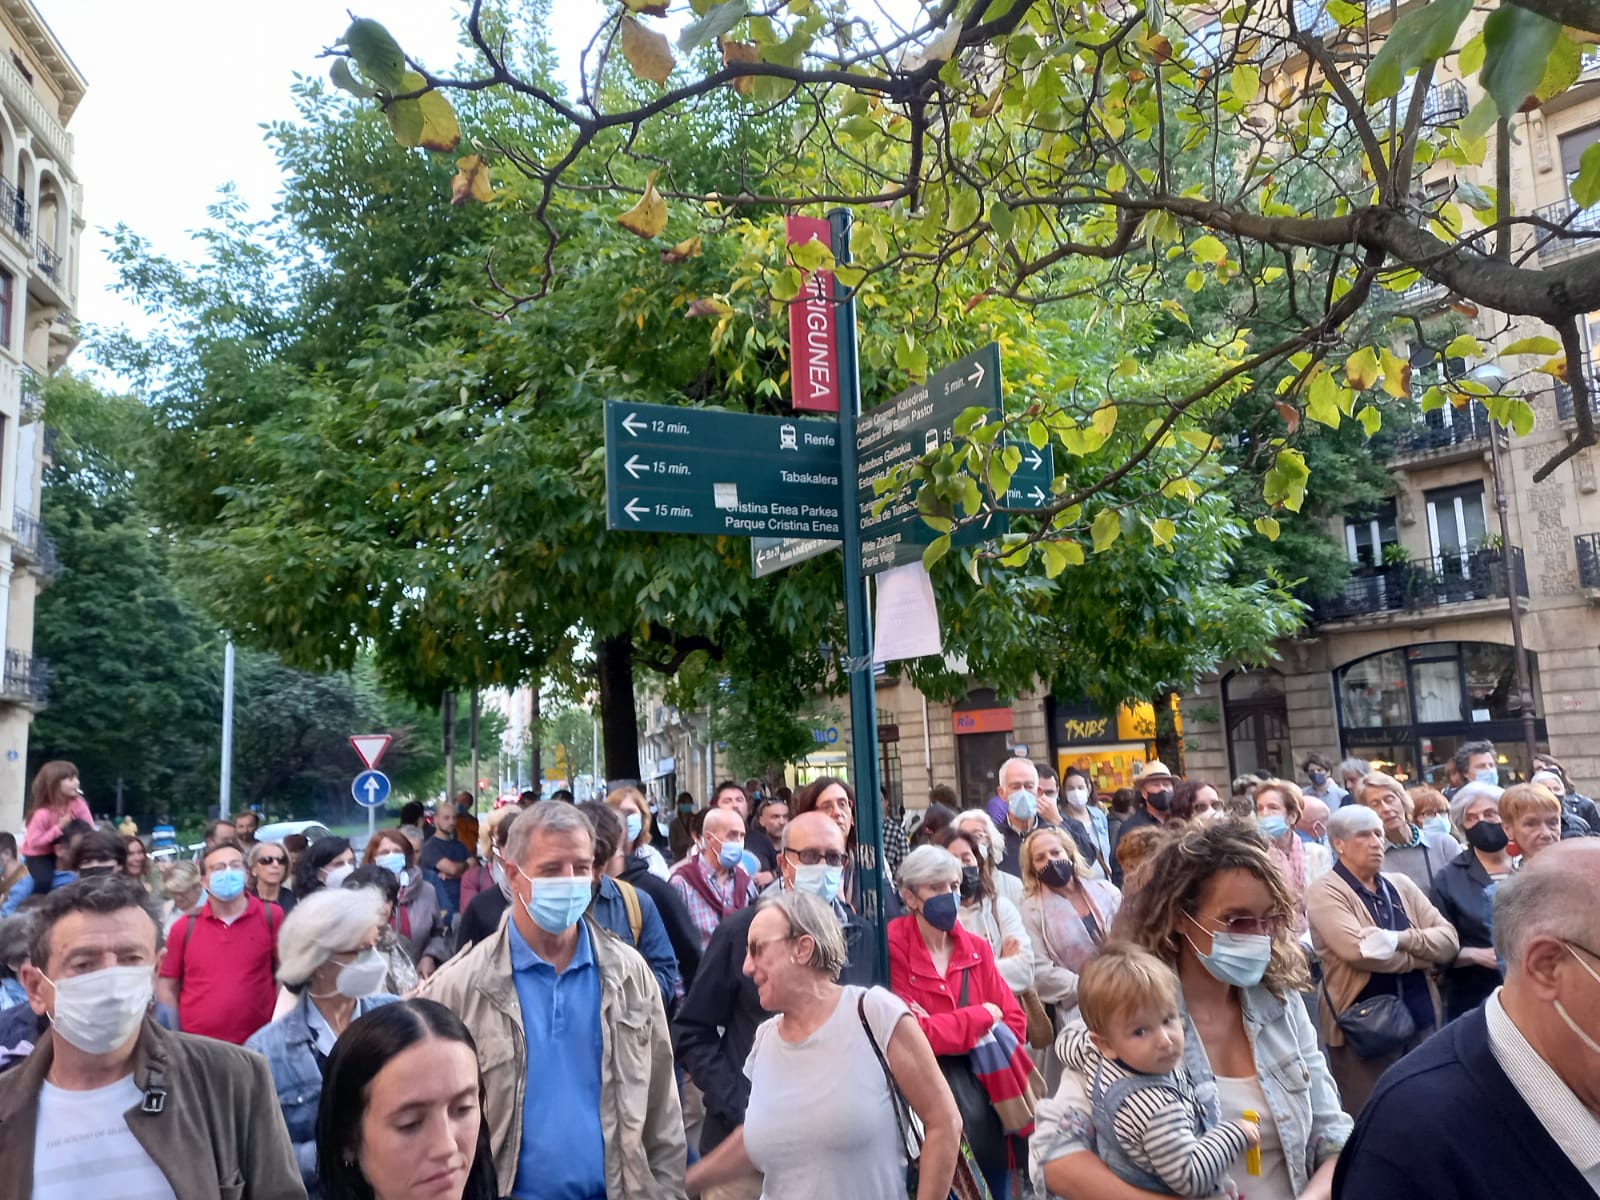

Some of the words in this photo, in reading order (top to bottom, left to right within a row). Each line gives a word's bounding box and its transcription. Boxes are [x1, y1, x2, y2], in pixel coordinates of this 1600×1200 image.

[807, 268, 831, 398] IRIGUNEA
[944, 382, 950, 396] 5
[950, 377, 966, 393] min.
[897, 389, 929, 413] Katedrala
[651, 420, 664, 433] 12
[666, 422, 690, 435] min.
[857, 427, 882, 450] Catedral
[893, 415, 911, 431] Buen
[911, 402, 934, 422] Pastor
[804, 433, 835, 446] Renfe
[943, 427, 952, 442] 15
[653, 462, 666, 474] 15
[668, 463, 692, 475] min.
[780, 470, 838, 486] Tabakalera
[654, 504, 668, 516] 15
[670, 505, 694, 518] min.
[771, 503, 799, 516] Enea
[801, 505, 838, 518] Parkea
[882, 507, 892, 521] de
[725, 516, 765, 531] Parque
[768, 519, 810, 532] Cristina
[812, 521, 839, 533] Enea
